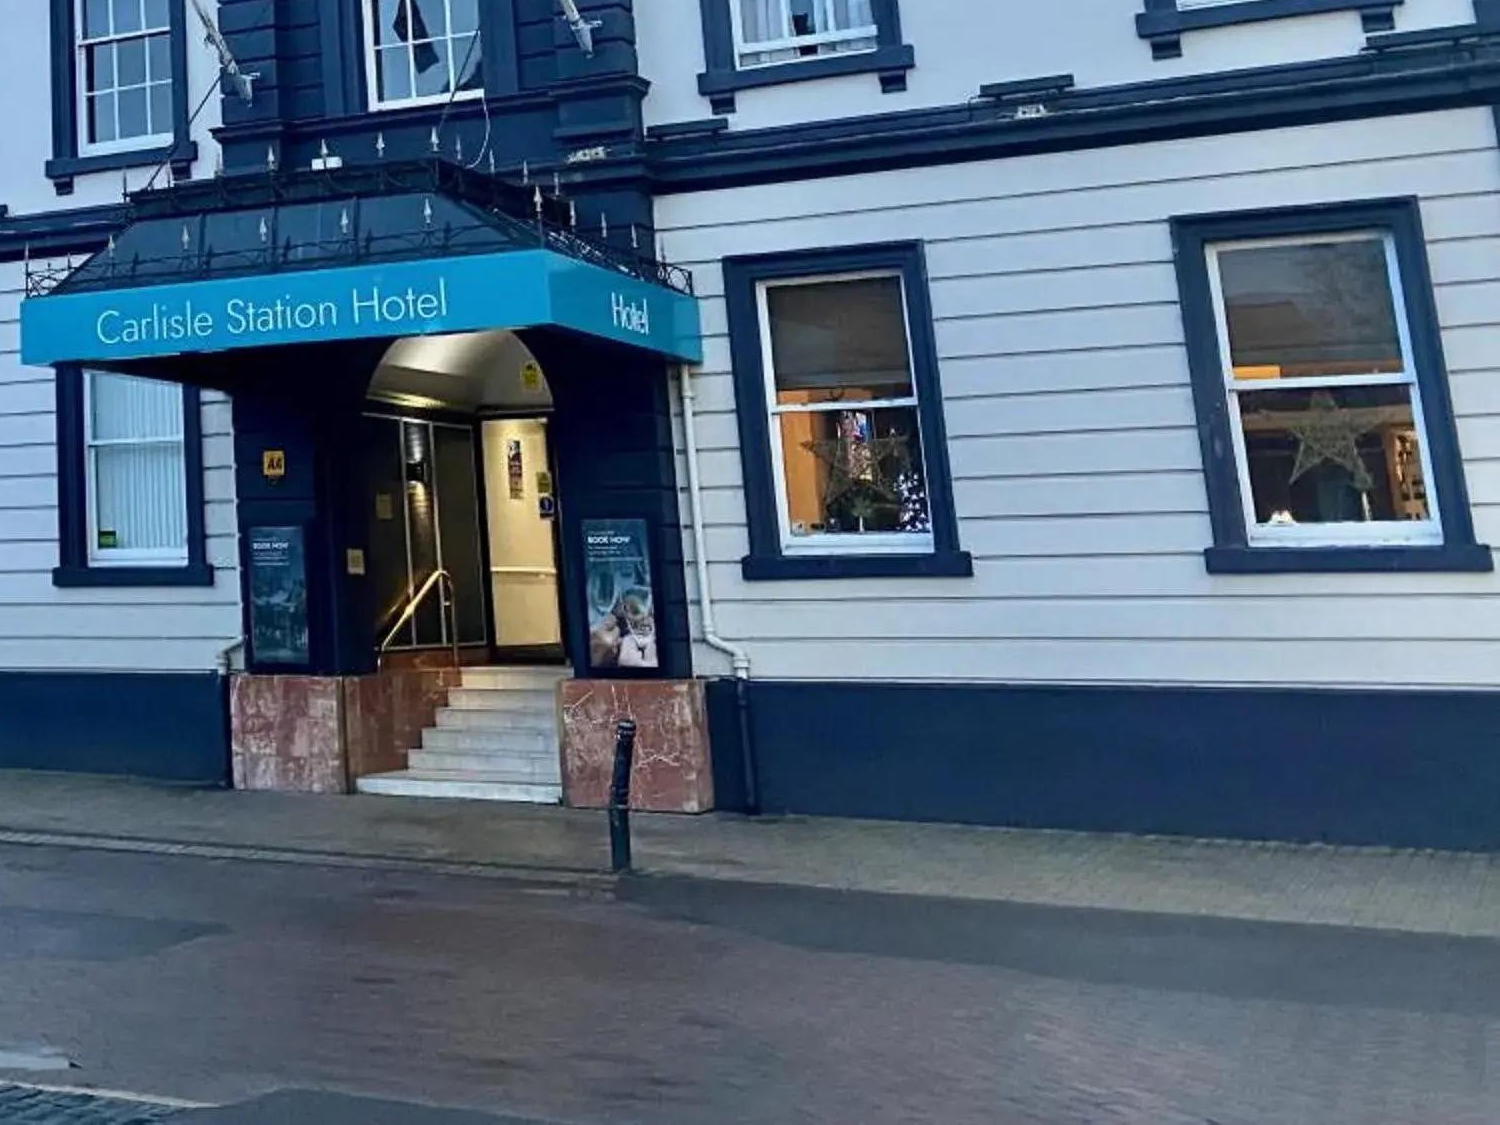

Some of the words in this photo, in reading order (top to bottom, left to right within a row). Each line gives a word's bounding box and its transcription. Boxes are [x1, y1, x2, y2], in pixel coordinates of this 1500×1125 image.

[97, 301, 213, 344] Carlisle
[227, 294, 337, 334] Station
[352, 278, 447, 324] Hotel
[611, 291, 649, 334] Hotel
